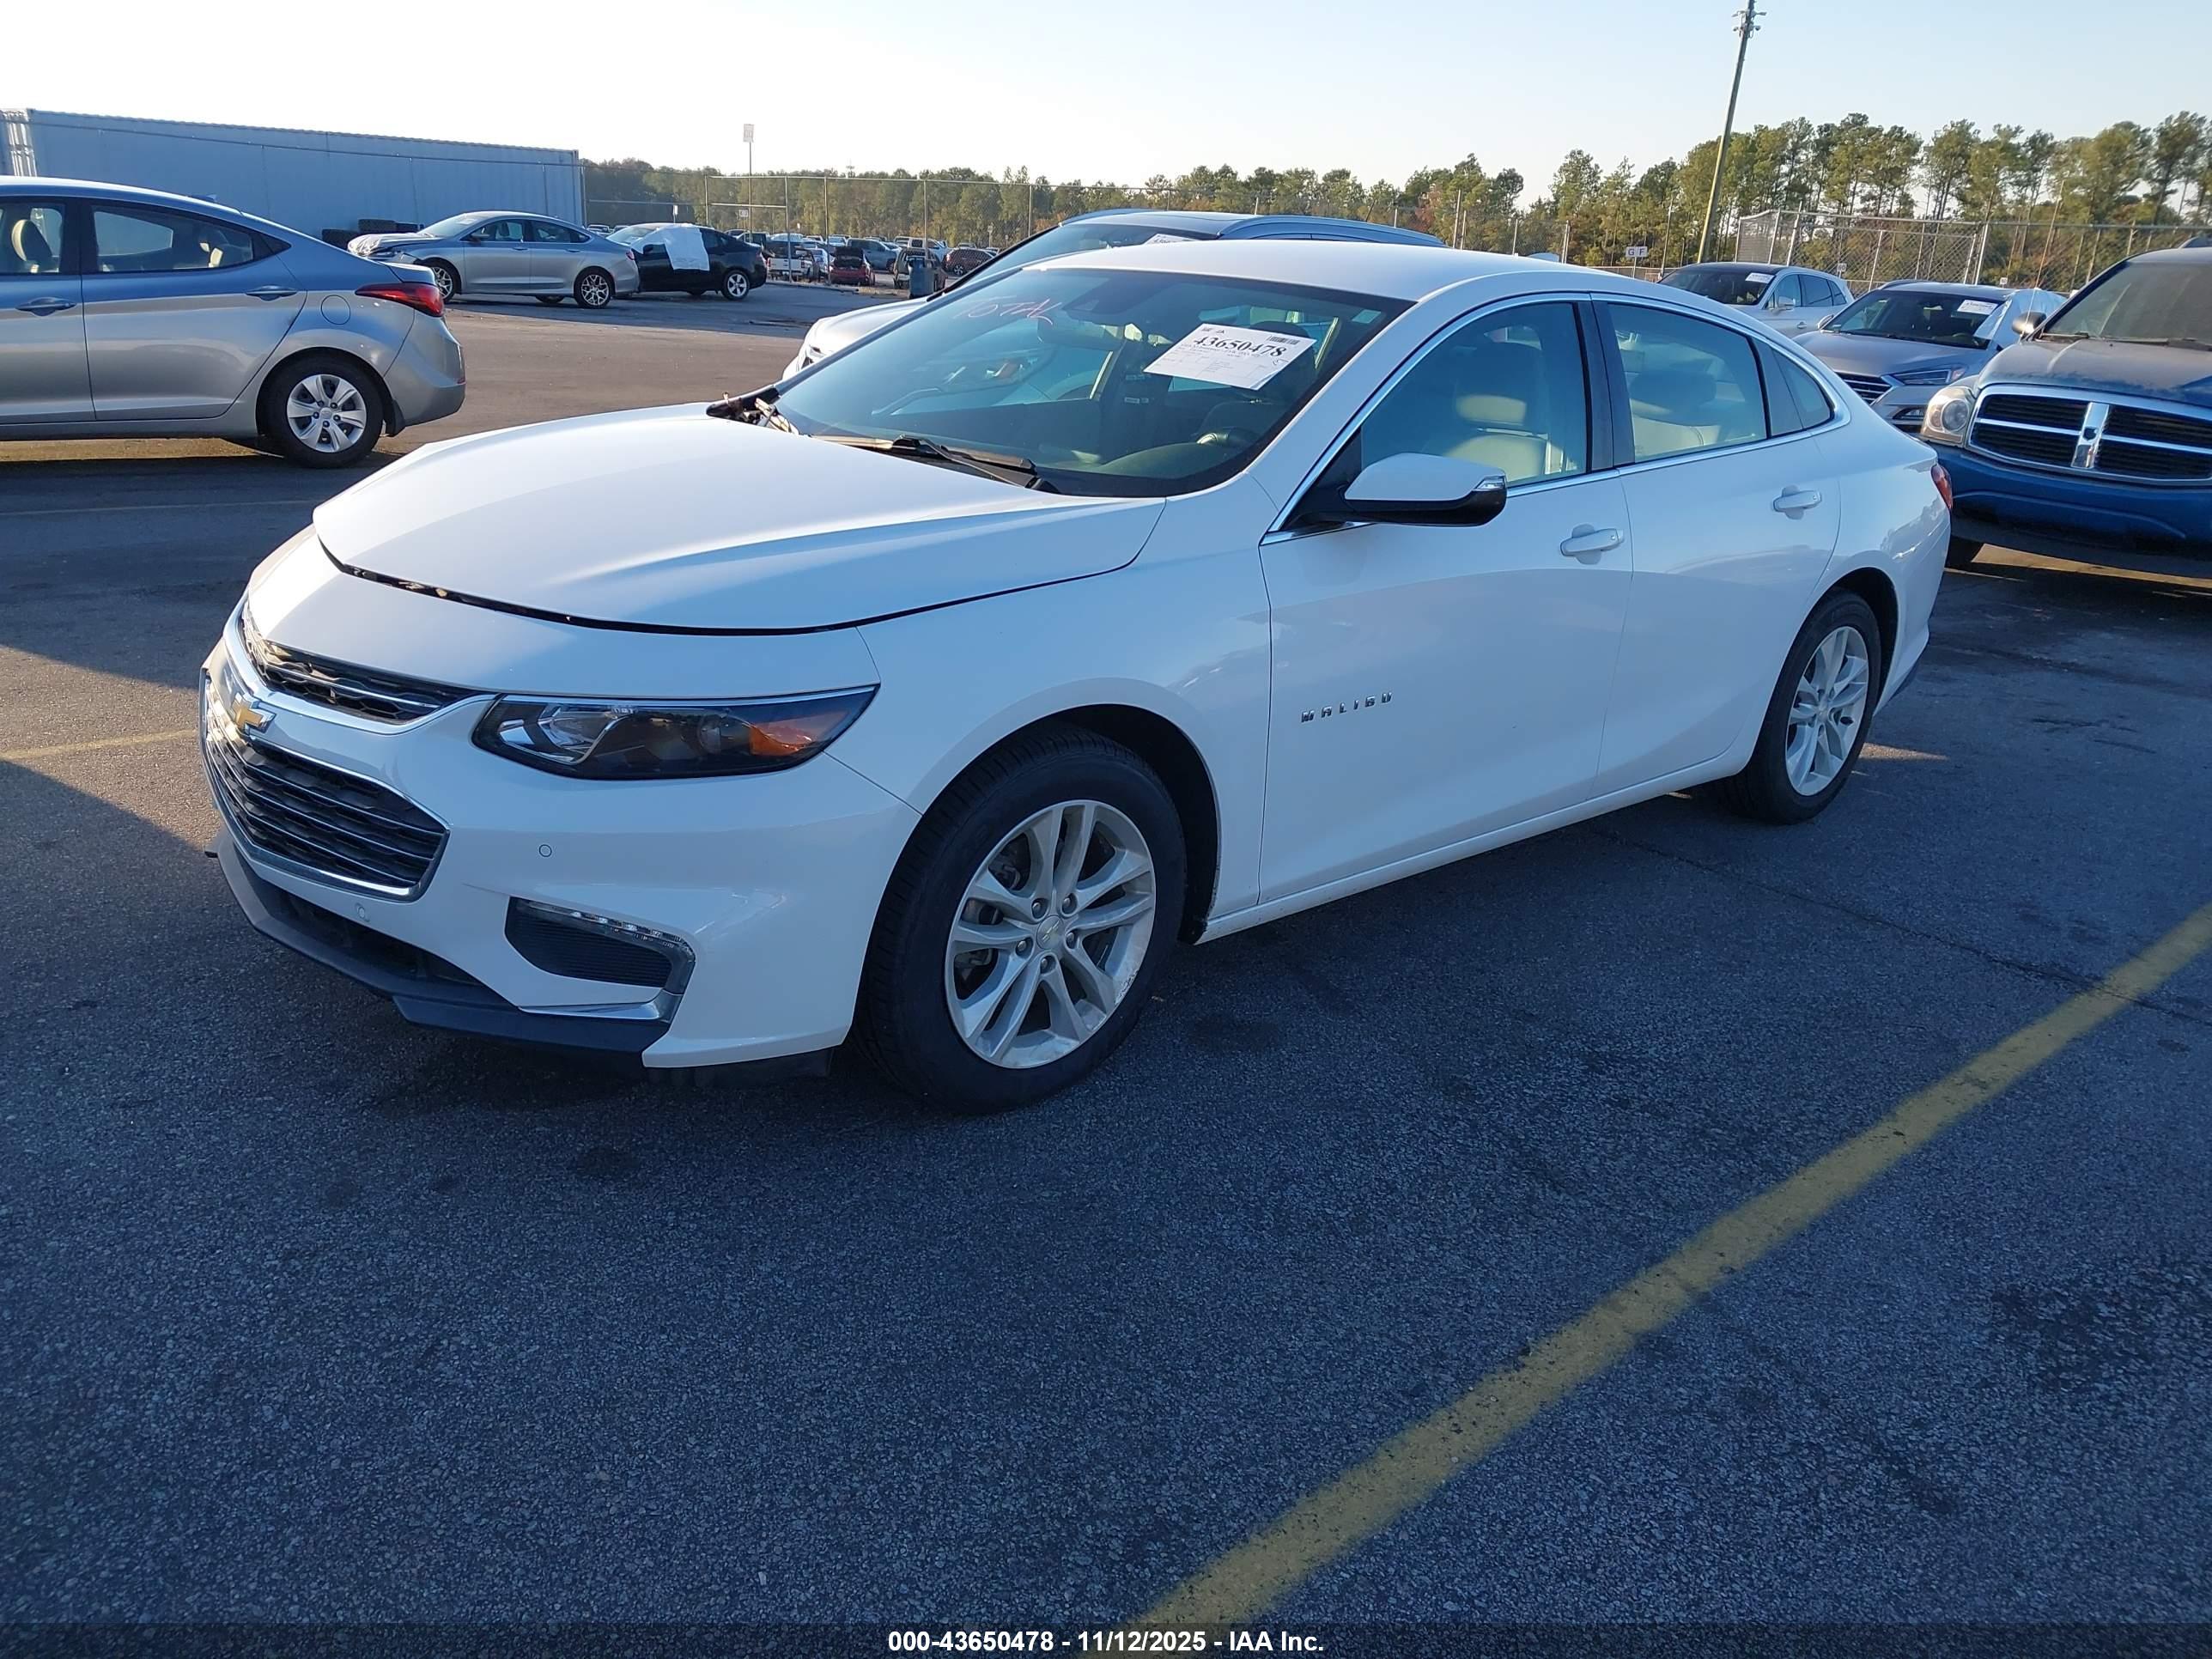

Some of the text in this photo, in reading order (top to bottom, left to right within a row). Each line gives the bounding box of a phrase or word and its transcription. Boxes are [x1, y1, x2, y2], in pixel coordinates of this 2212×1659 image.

[1638, 247, 1645, 256] F
[1193, 335, 1287, 357] 43650478
[1301, 691, 1393, 723] MALIBU
